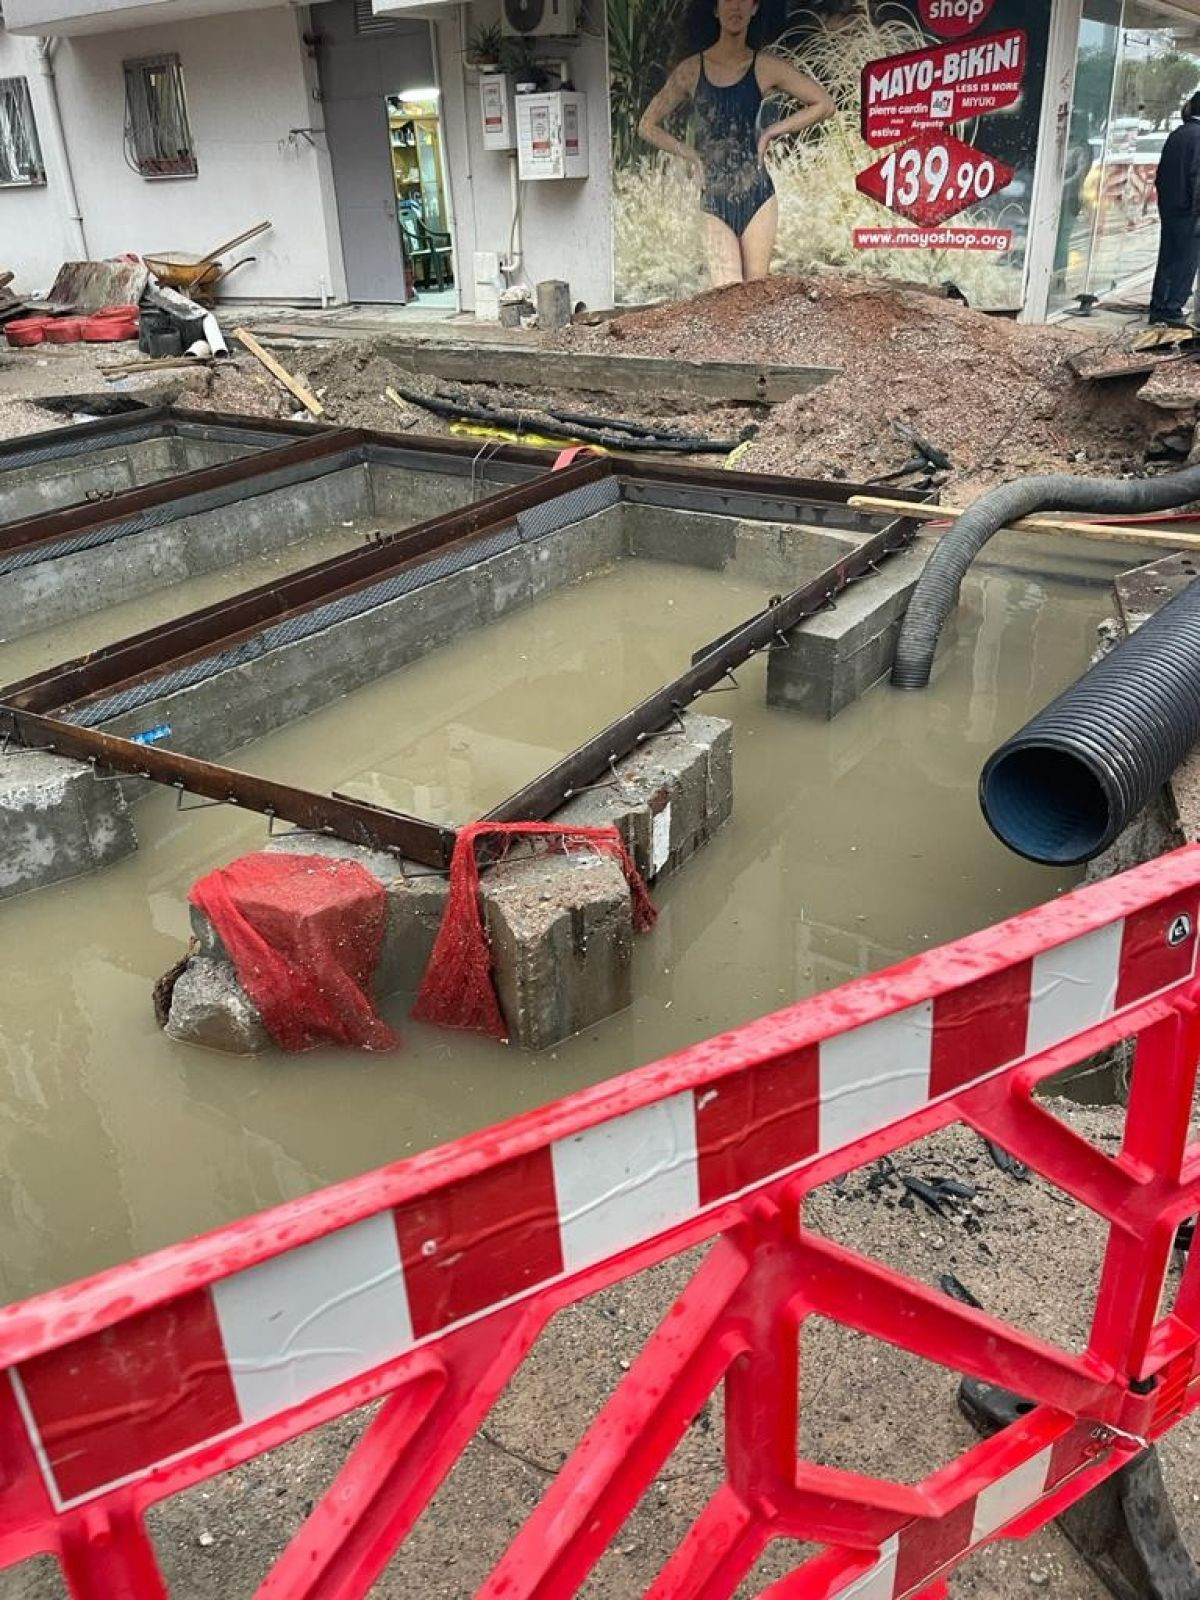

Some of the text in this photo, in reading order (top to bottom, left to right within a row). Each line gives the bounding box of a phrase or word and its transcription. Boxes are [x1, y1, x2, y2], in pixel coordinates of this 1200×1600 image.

[929, 0, 984, 22] shop
[955, 81, 1019, 93] LESS IS MORE
[868, 102, 929, 117] pierre cardin
[870, 127, 901, 137] estiva
[879, 146, 995, 207] 139.90
[858, 230, 1008, 249] www.mayoshop.org
